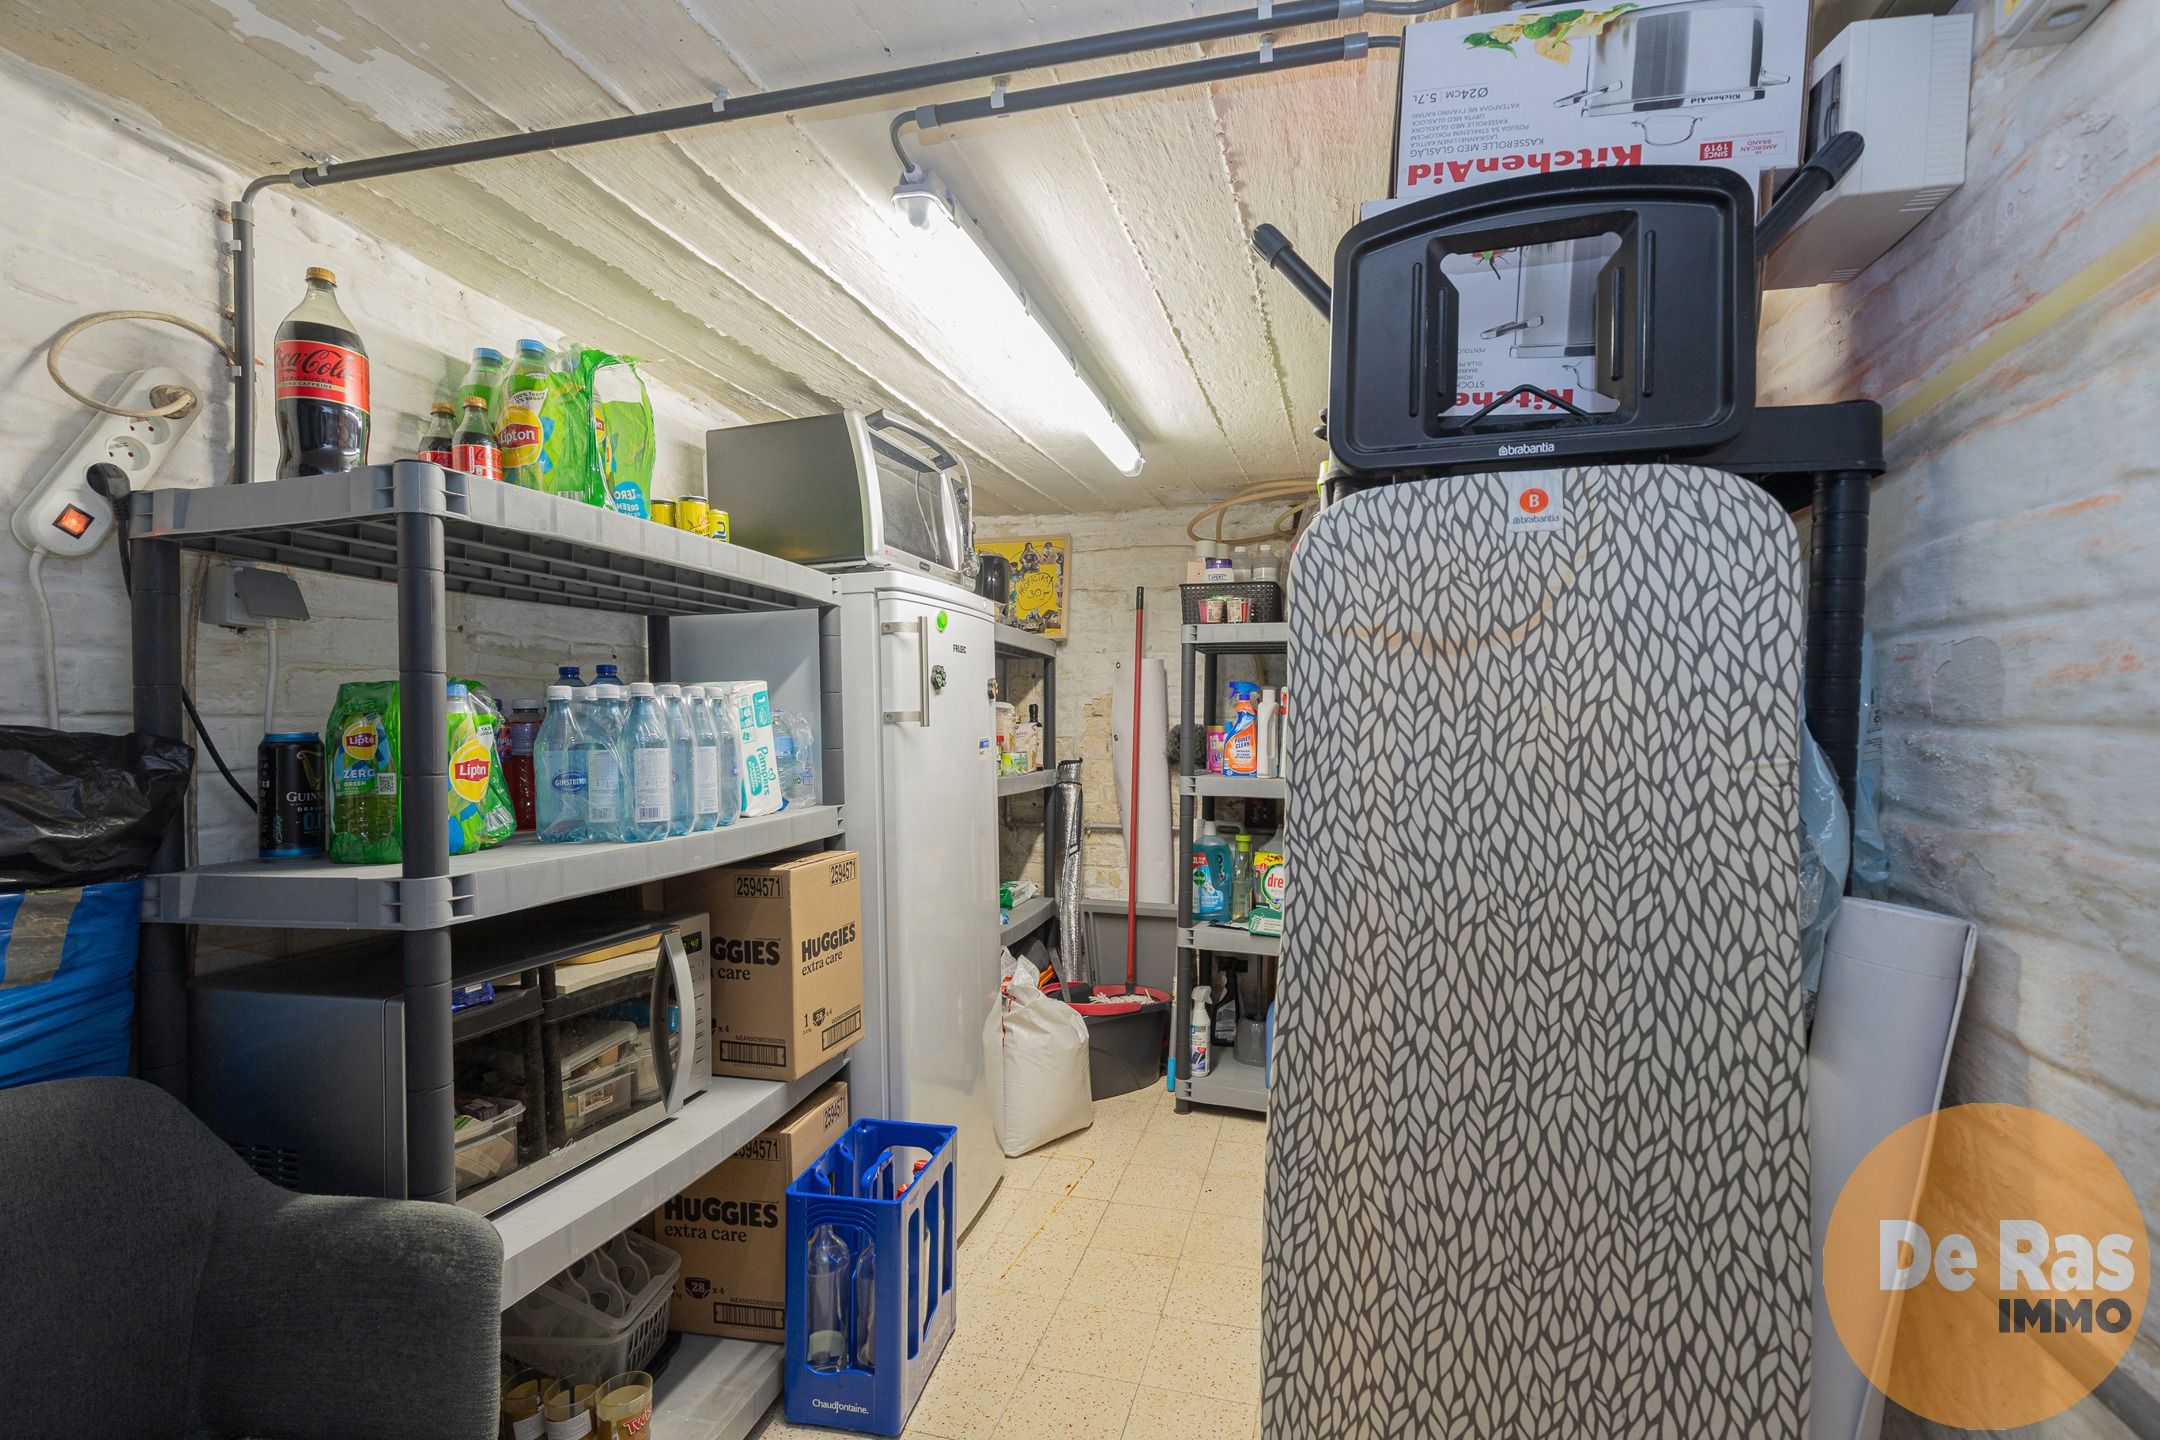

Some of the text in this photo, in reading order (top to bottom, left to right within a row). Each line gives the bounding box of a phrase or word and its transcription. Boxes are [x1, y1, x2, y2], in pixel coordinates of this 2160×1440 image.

[1690, 93, 1741, 105] KitchenAid
[1445, 116, 1462, 124] MED
[1410, 137, 1544, 158] KASSEROLLE MED GLASLÅG
[1703, 143, 1729, 152] 1919
[1703, 150, 1729, 159] SINCE
[1407, 144, 1643, 186] KitchenAid
[500, 429, 535, 445] Lipton
[1508, 443, 1554, 456] brabantia
[1529, 494, 1540, 508] B
[1520, 514, 1559, 525] brabantia
[343, 768, 376, 780] ZERO
[756, 746, 770, 796] Pampers
[830, 861, 856, 884] 2594571
[736, 877, 781, 897] 2594571
[801, 923, 856, 963] HUGGIES
[801, 950, 843, 977] extra care
[717, 968, 751, 981] care
[732, 1139, 779, 1160] 594571
[664, 1195, 779, 1229] HUGGIES
[664, 1223, 748, 1243] extra care
[691, 1281, 706, 1294] 28
